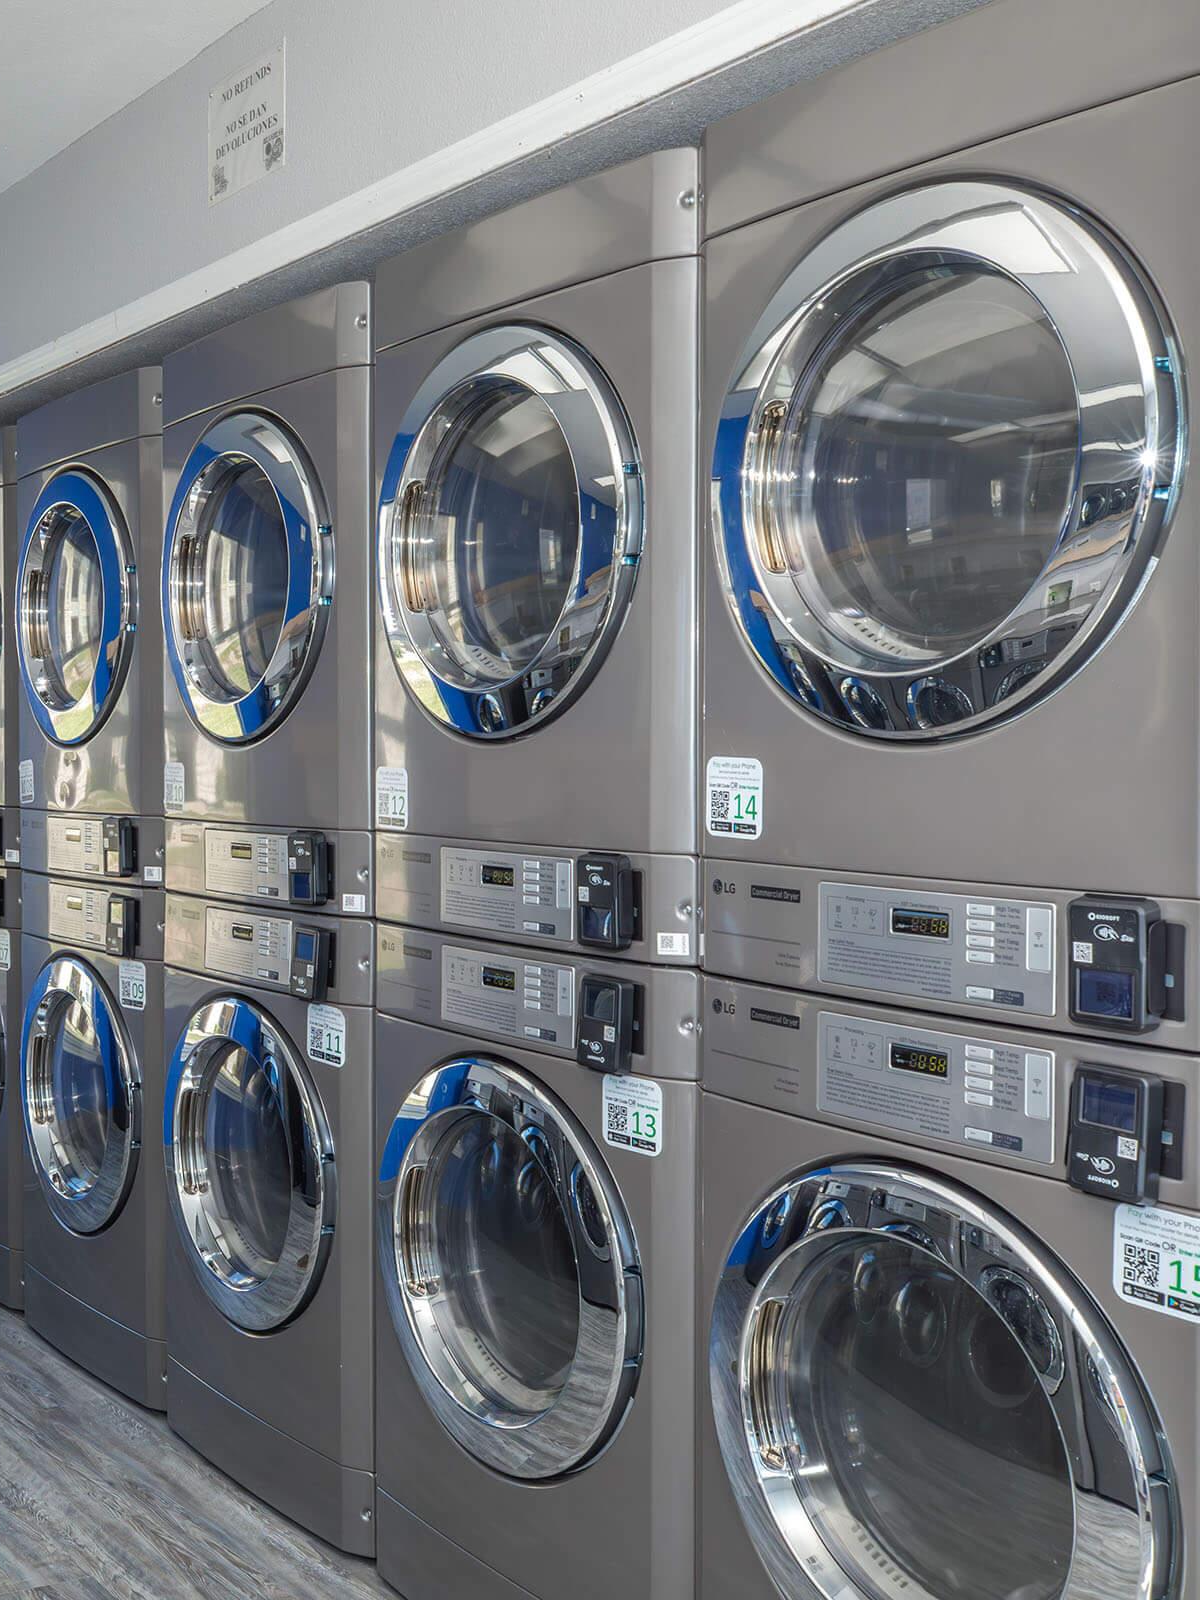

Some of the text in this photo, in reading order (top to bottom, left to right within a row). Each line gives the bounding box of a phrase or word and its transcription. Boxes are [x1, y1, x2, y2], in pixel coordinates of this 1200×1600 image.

[222, 62, 271, 102] NO REFUNDS
[226, 102, 267, 135] NO SE DAN
[216, 113, 278, 160] DEVOLUCIONES
[392, 796, 405, 816] 12
[734, 794, 758, 820] 14
[132, 982, 144, 999] 09
[326, 1032, 342, 1054] 11
[632, 1112, 656, 1138] 13
[1128, 1208, 1143, 1218] Pay
[1145, 1212, 1162, 1222] with
[1163, 1217, 1181, 1227] your
[1145, 1239, 1160, 1248] Code
[1162, 1242, 1176, 1252] OR
